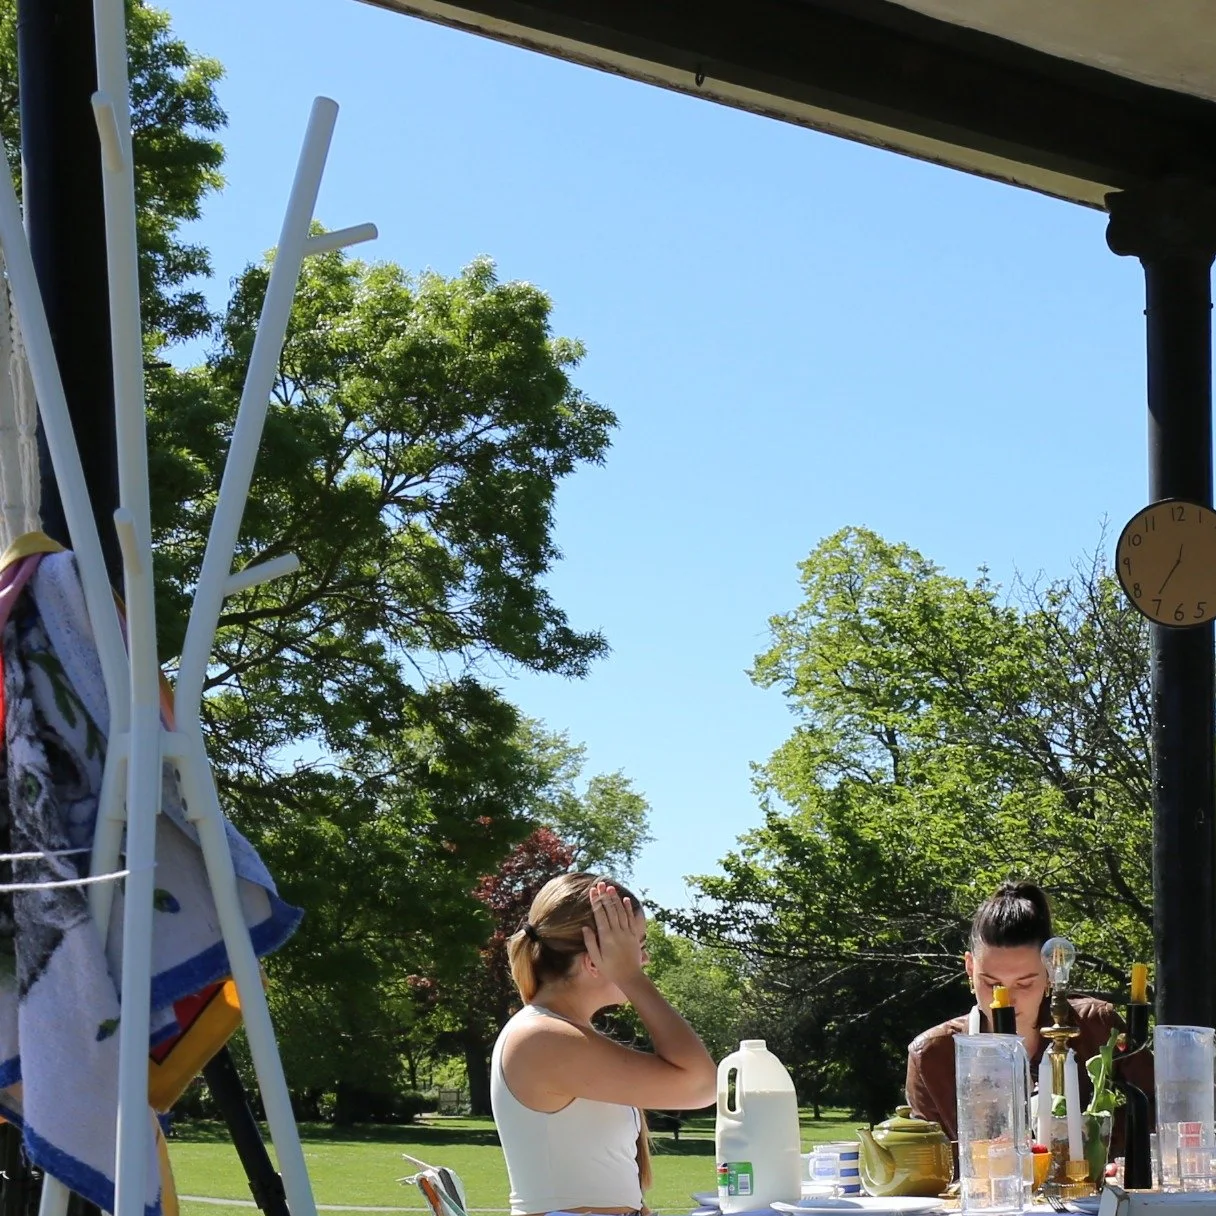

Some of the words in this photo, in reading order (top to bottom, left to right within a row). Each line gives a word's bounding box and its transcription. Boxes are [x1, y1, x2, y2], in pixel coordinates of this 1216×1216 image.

[1171, 506, 1185, 522] 12
[1198, 510, 1202, 524] 1
[1144, 516, 1156, 533] 11
[1127, 534, 1142, 547] 10
[1123, 557, 1132, 576] 9
[1133, 583, 1142, 599] 8
[1152, 599, 1162, 616] 7
[1174, 603, 1184, 621] 6
[1193, 602, 1207, 619] 5
